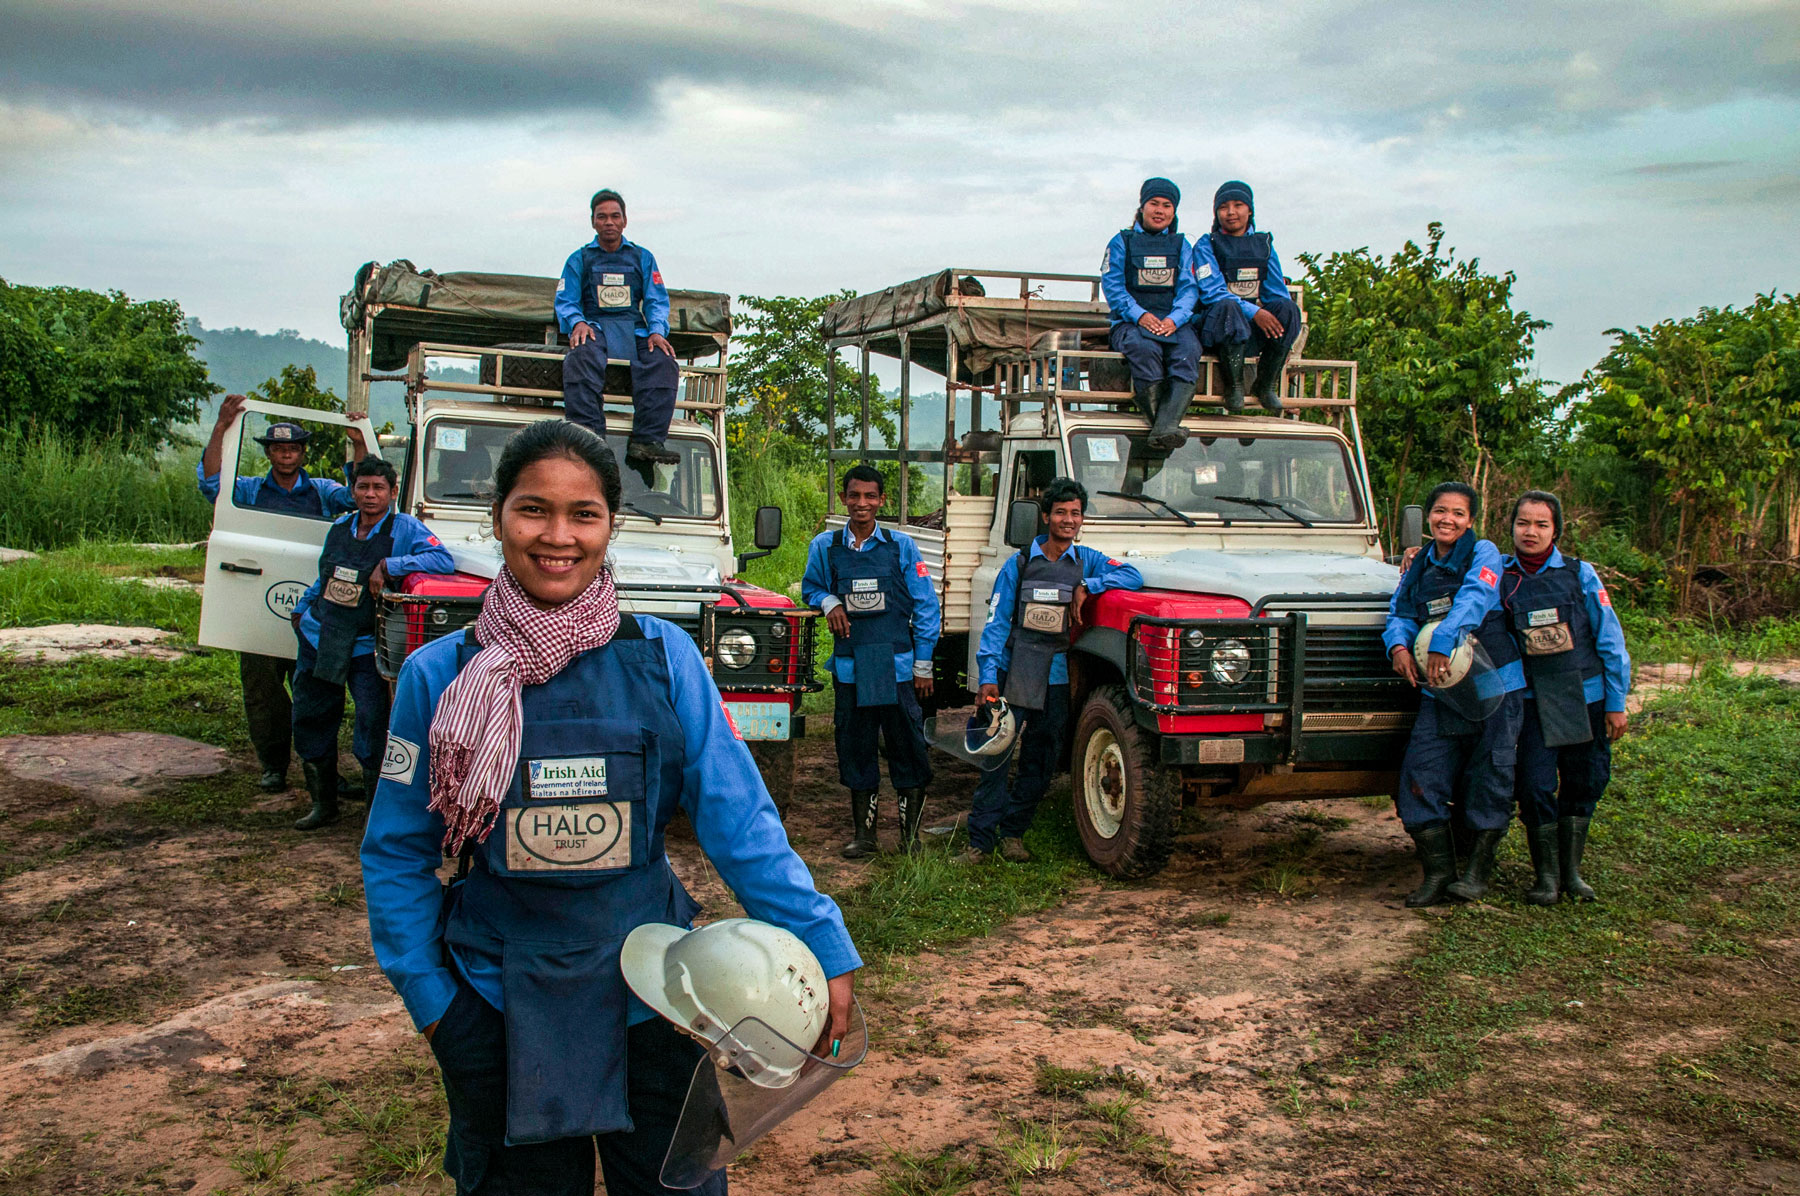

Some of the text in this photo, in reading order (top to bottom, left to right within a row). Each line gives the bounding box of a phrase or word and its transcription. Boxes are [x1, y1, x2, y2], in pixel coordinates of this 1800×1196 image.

[604, 291, 625, 299] HALO
[332, 583, 354, 596] HALO
[853, 593, 877, 601] HALO
[1032, 613, 1056, 622] HALO
[1533, 633, 1561, 643] HALO
[384, 750, 405, 764] LO
[543, 765, 606, 779] Irish Aid
[531, 781, 574, 789] Government
[584, 779, 607, 787] Ireland
[531, 789, 557, 797] Rialtas
[533, 812, 607, 836] HALO
[554, 839, 588, 849] TRUST
